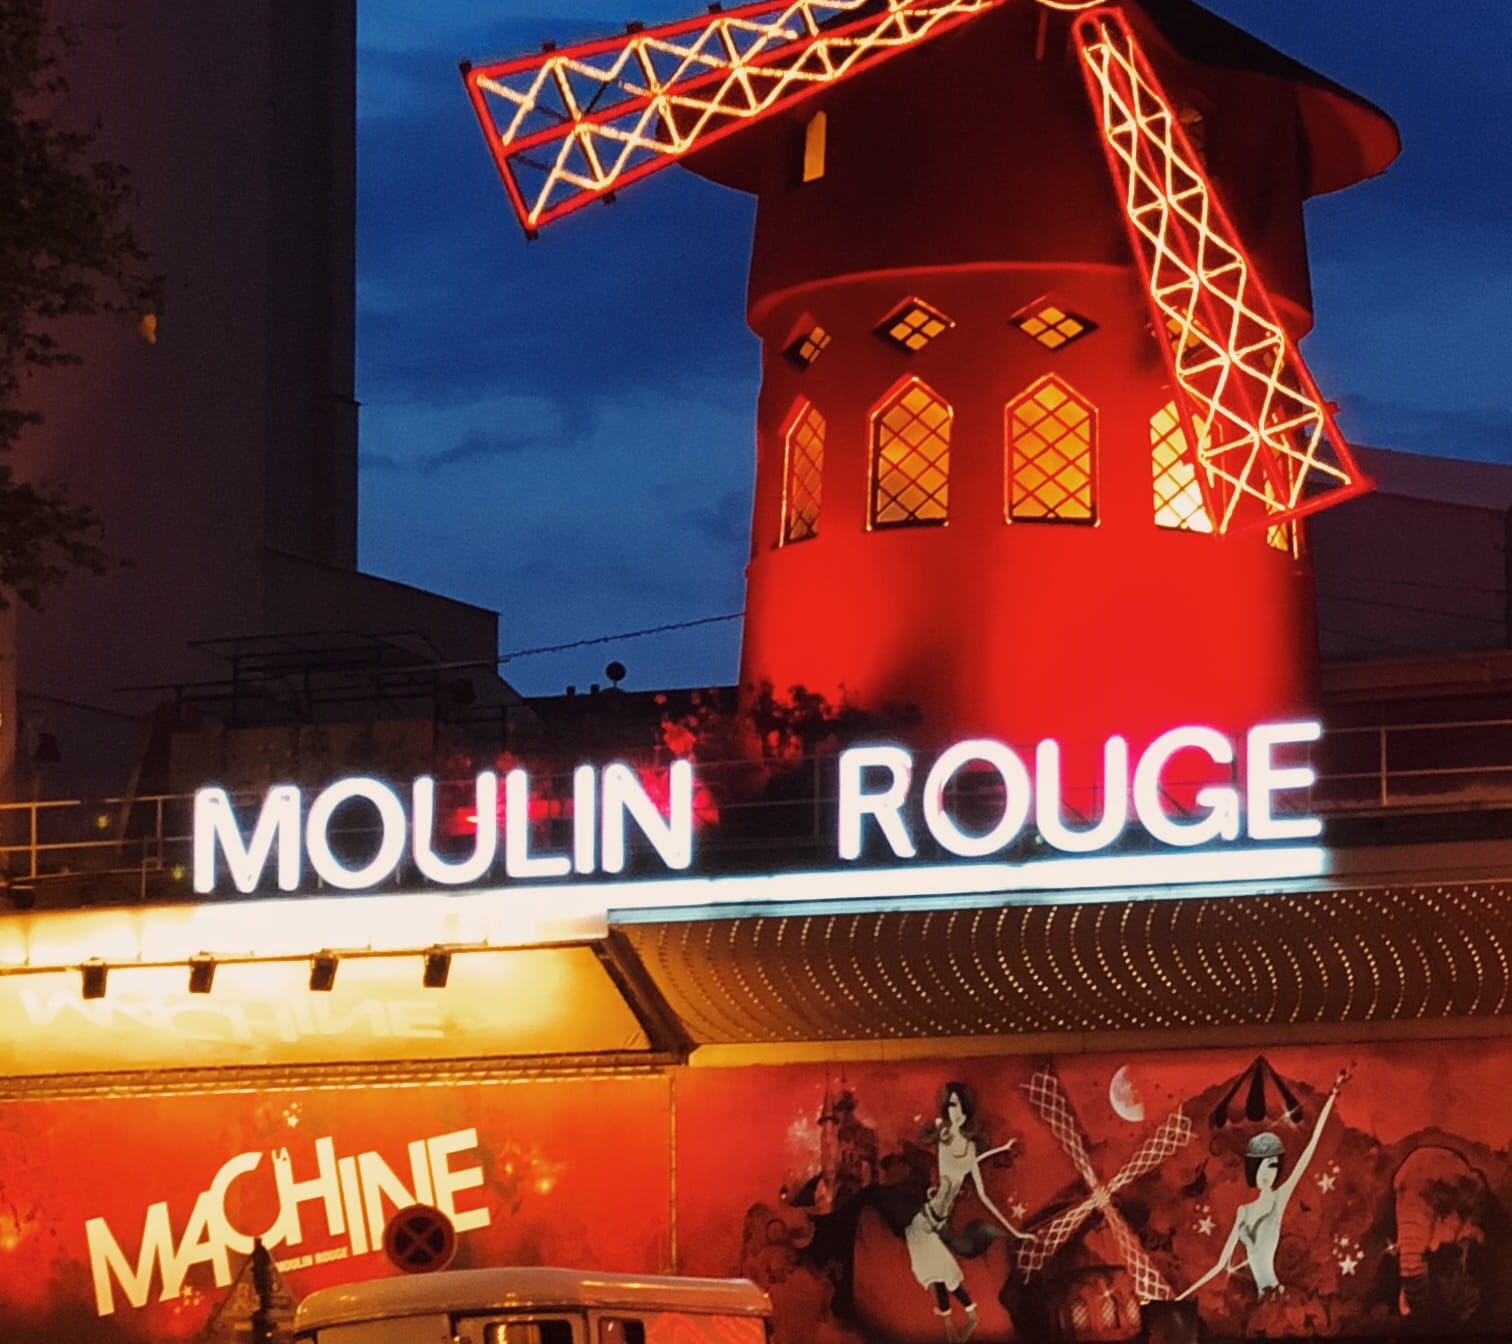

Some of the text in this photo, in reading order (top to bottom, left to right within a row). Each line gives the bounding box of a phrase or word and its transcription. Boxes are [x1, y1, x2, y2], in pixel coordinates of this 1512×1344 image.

[194, 722, 1323, 894] MOULIN ROUGE
[85, 1129, 491, 1317] MACHINE
